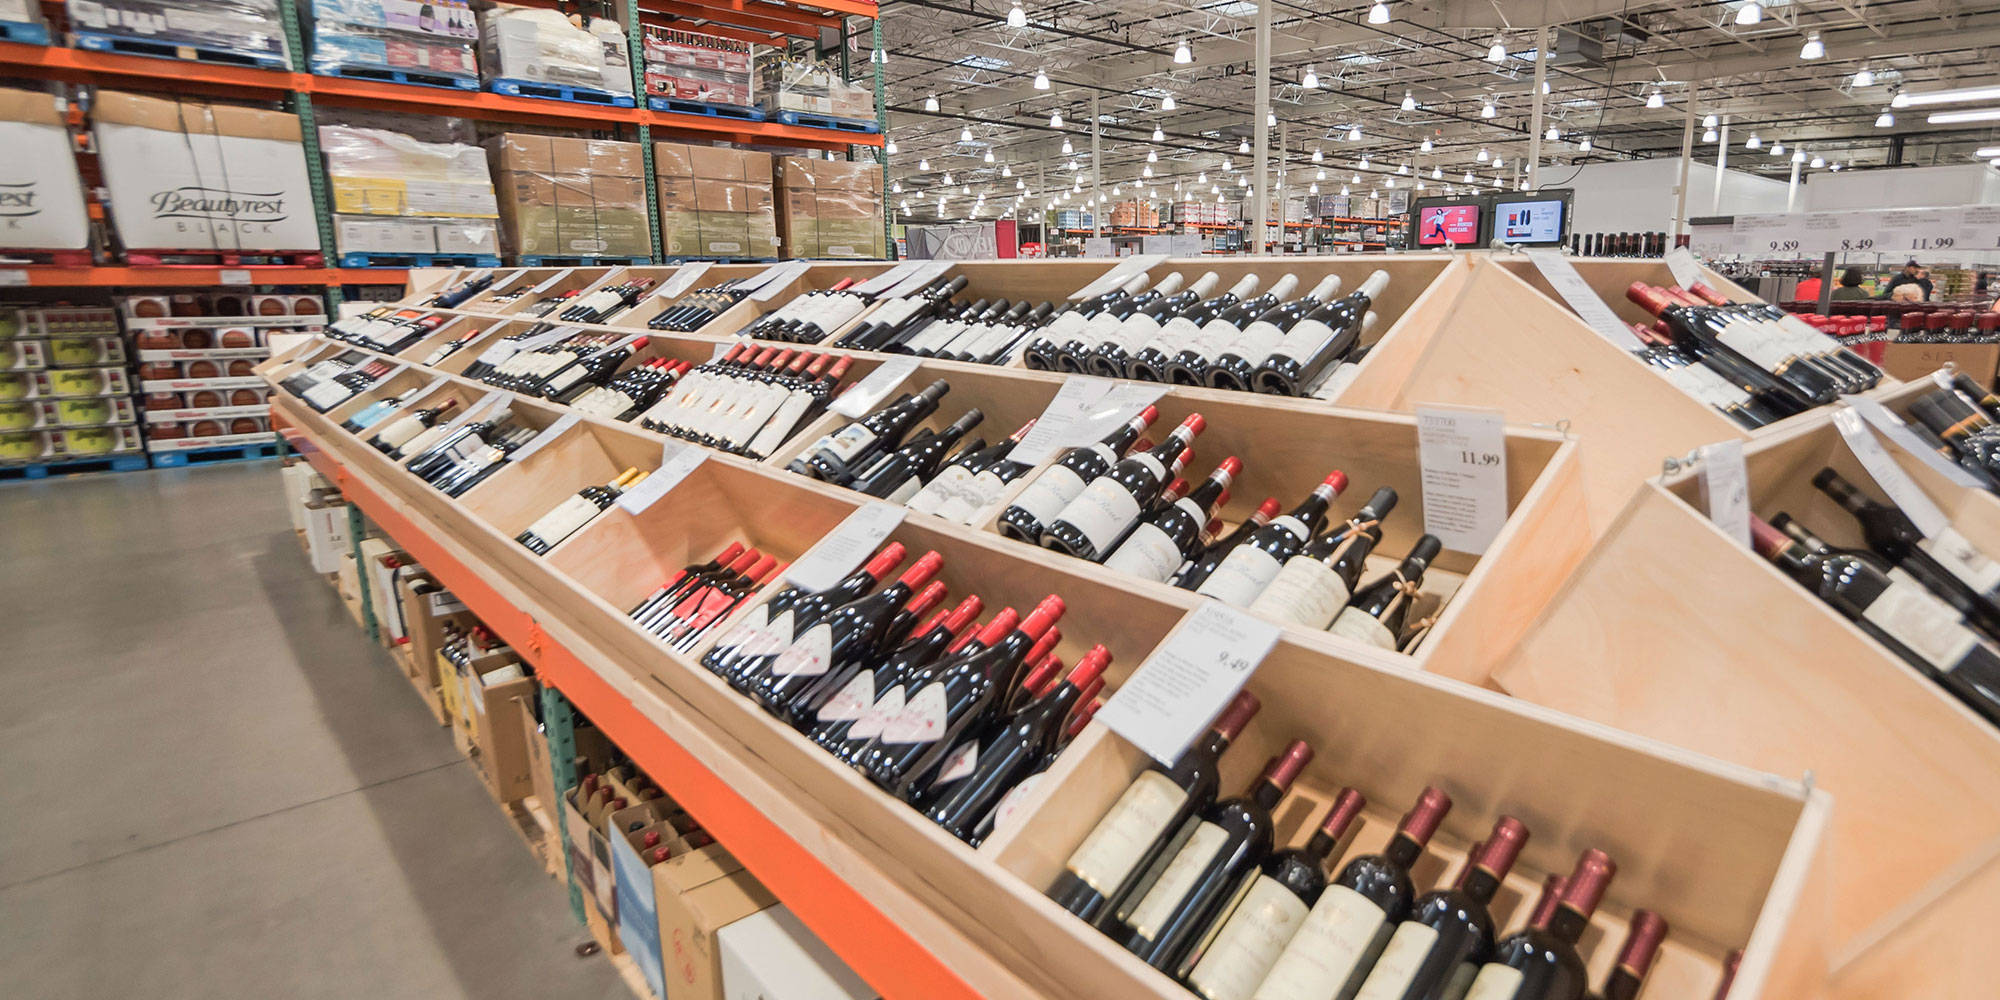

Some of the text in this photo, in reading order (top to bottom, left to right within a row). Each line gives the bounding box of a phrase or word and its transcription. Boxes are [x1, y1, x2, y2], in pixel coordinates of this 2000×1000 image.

[150, 190, 286, 217] Beautyrest
[176, 222, 273, 234] BLACK
[1769, 240, 1799, 252] 9.89
[1840, 238, 1874, 251] 8.49
[1911, 236, 1955, 250] 11.99
[1461, 450, 1500, 467] 11.99
[1219, 650, 1250, 672] 9.49
